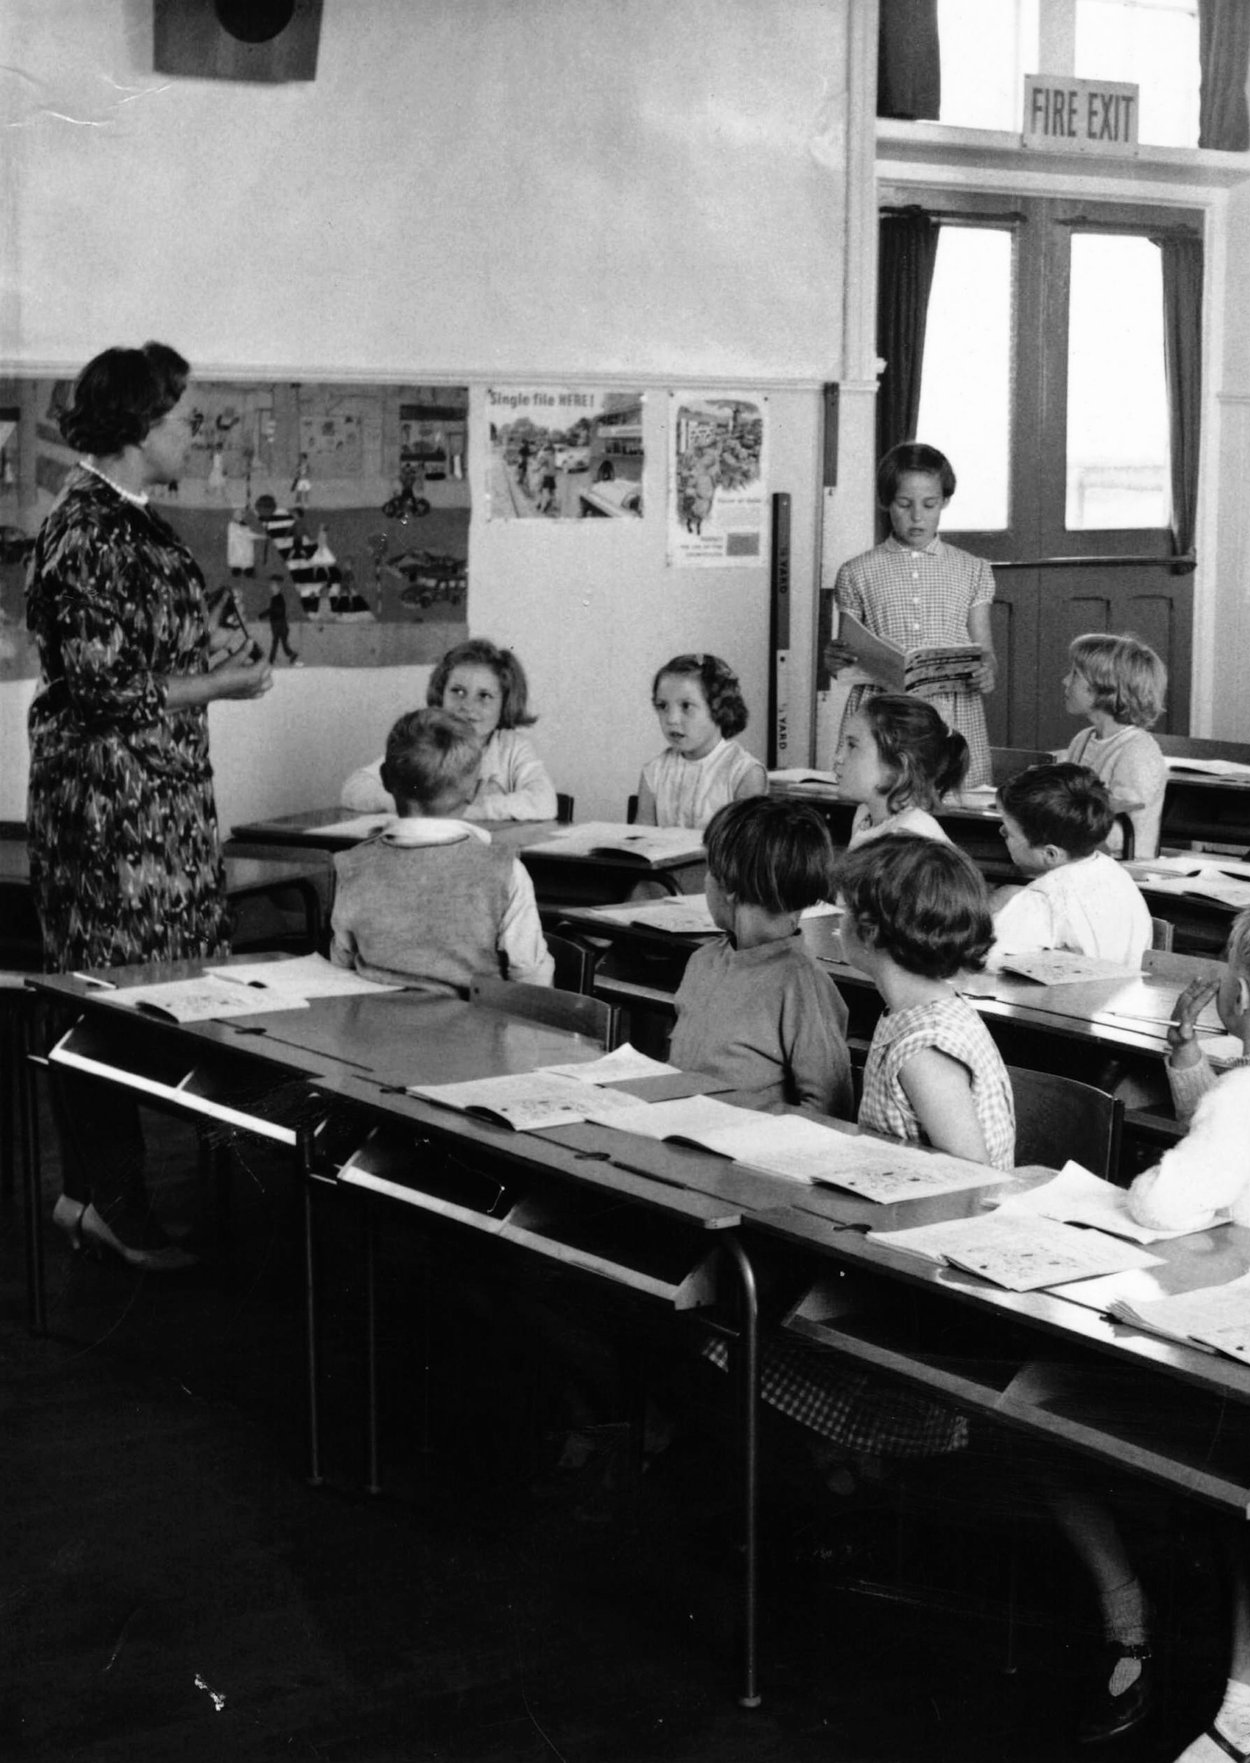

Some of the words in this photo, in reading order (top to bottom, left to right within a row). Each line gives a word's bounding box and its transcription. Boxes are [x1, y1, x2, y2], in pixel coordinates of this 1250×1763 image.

[1030, 87, 1077, 137] FIRE
[1087, 92, 1135, 142] EXIT
[490, 391, 530, 409] Single
[533, 392, 555, 407] file
[778, 716, 788, 750] YARD
